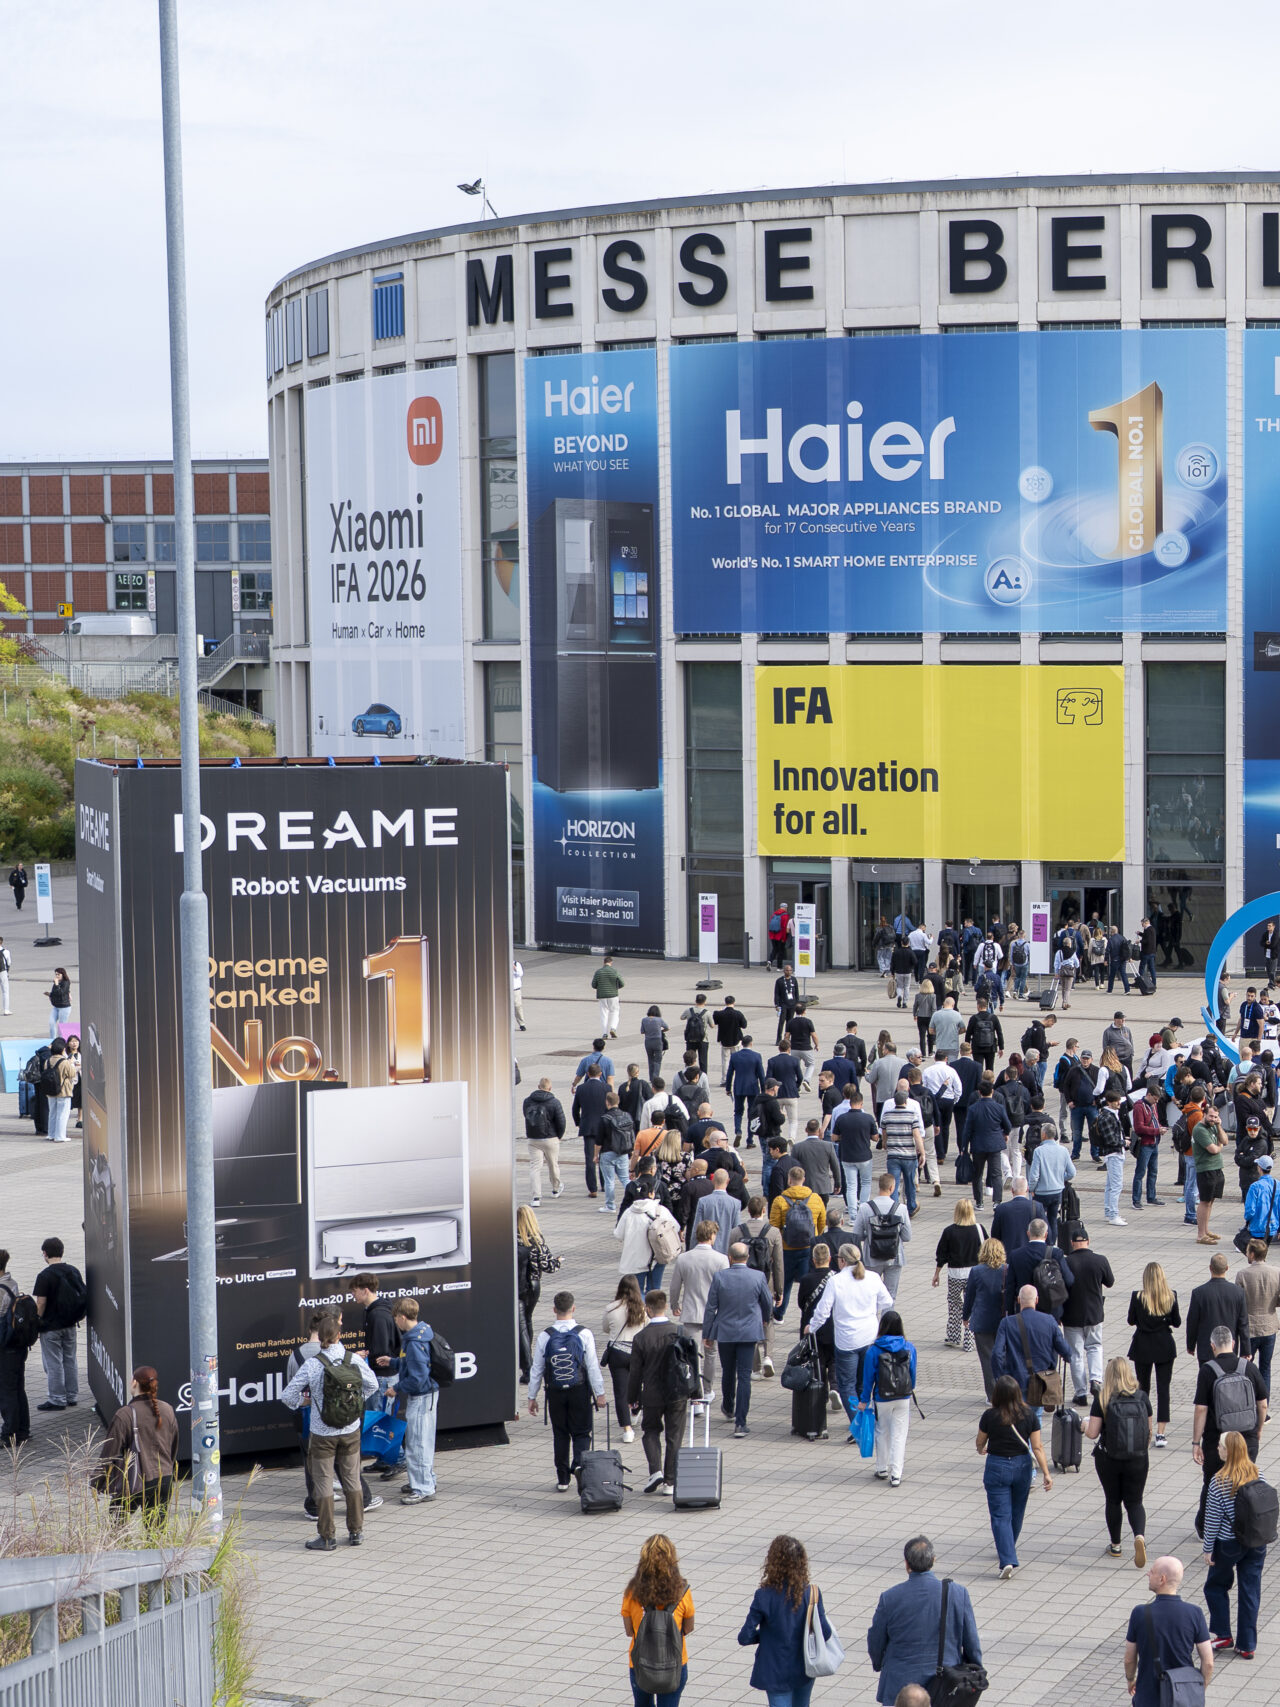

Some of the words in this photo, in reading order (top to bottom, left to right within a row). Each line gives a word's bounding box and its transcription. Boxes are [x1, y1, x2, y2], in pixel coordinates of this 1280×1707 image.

[467, 228, 814, 327] MESSE
[544, 375, 635, 417] Haier
[554, 434, 629, 455] BEYOND
[725, 400, 956, 485] Haier
[1128, 416, 1144, 460] NO.1
[553, 460, 583, 473] WHAT
[585, 460, 606, 472] YOU
[609, 459, 629, 470] SEE
[1187, 465, 1211, 477] IoT
[690, 506, 712, 518] No.
[715, 506, 720, 518] 1
[723, 504, 780, 518] GLOBAL
[787, 503, 839, 517] MAJOR
[843, 502, 940, 516] APPLIANCES
[944, 501, 1002, 514] BRAND
[1128, 465, 1144, 550] GLOBAL
[330, 493, 424, 553] Xiaomi
[765, 522, 782, 534] for
[785, 522, 797, 533] 17
[799, 521, 878, 533] Consecutive
[880, 520, 916, 532] Years
[761, 557, 782, 568] No.
[785, 557, 790, 567] 1
[793, 556, 840, 568] SMART
[843, 555, 886, 567] HOME
[889, 554, 977, 566] ENTERPRISE
[331, 562, 361, 603] IFA
[367, 559, 427, 602] 2026
[332, 622, 358, 639] Human
[368, 622, 384, 639] Car
[395, 621, 425, 638] Home
[773, 686, 833, 724] IFA
[773, 759, 939, 792] Innovation
[80, 804, 109, 851] DREAME
[567, 819, 635, 839] HORIZON
[773, 802, 816, 835] for
[822, 803, 868, 835] all.
[174, 807, 459, 853] DREAME
[568, 849, 636, 859] COLLECTION
[231, 876, 300, 896] Robot
[306, 875, 408, 894] Vacuums
[562, 895, 579, 904] Visit
[580, 896, 600, 906] Haier
[602, 898, 634, 908] Pavilion
[562, 907, 576, 916] Hall
[579, 908, 588, 917] 3.1
[596, 909, 619, 919] Stand
[622, 911, 634, 920] 101
[235, 1273, 265, 1284] Ultra
[298, 1294, 344, 1308] Aqua20
[376, 1290, 397, 1300] ltra
[398, 1286, 431, 1298] Roller
[432, 1284, 442, 1294] X
[236, 1341, 266, 1350] Dreame
[267, 1337, 296, 1347] Ranked
[257, 1350, 278, 1359] Sales
[217, 1372, 283, 1406] Hall
